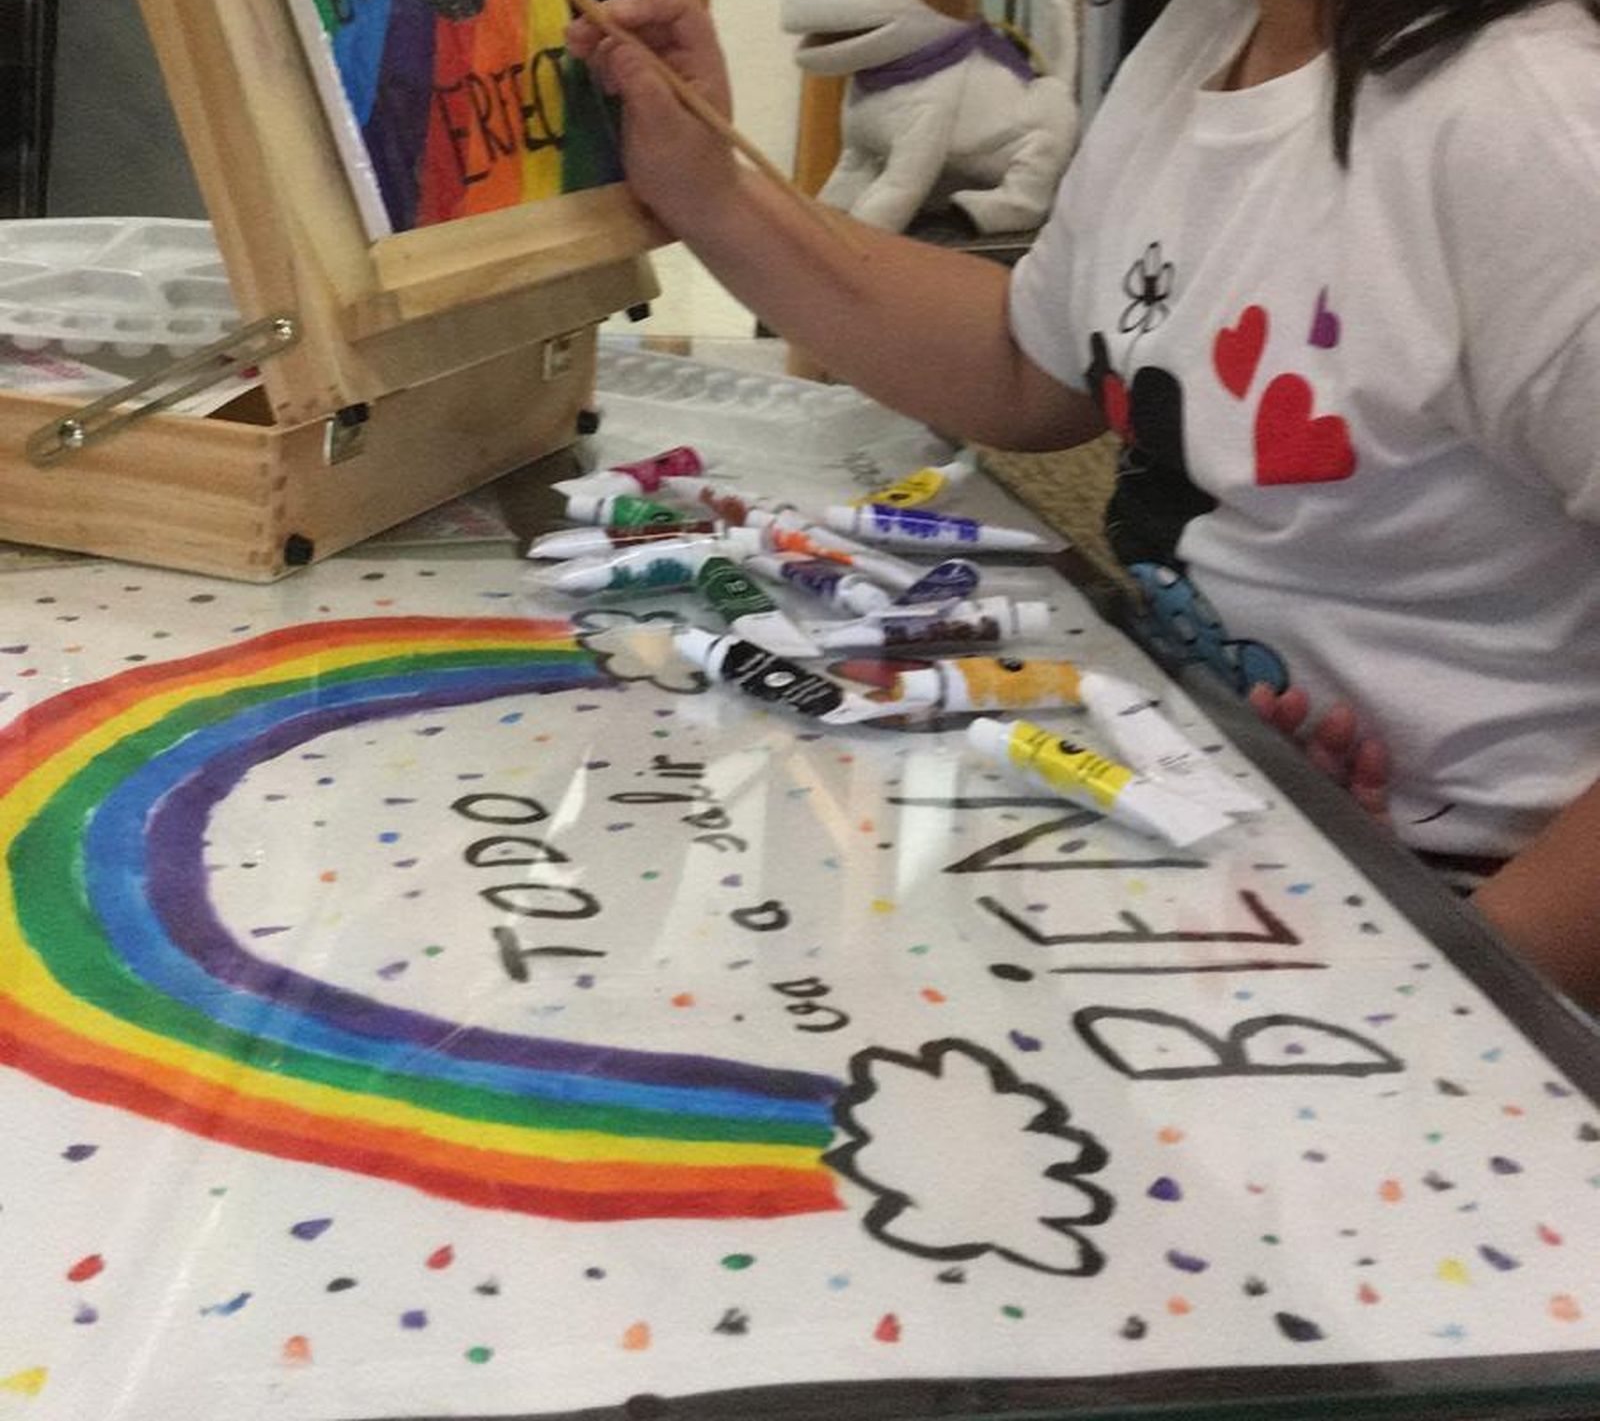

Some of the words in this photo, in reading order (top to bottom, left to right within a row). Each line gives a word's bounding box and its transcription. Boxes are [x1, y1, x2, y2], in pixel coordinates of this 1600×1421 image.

[608, 753, 749, 854] salir
[450, 792, 607, 983] TODO
[730, 899, 791, 932] a
